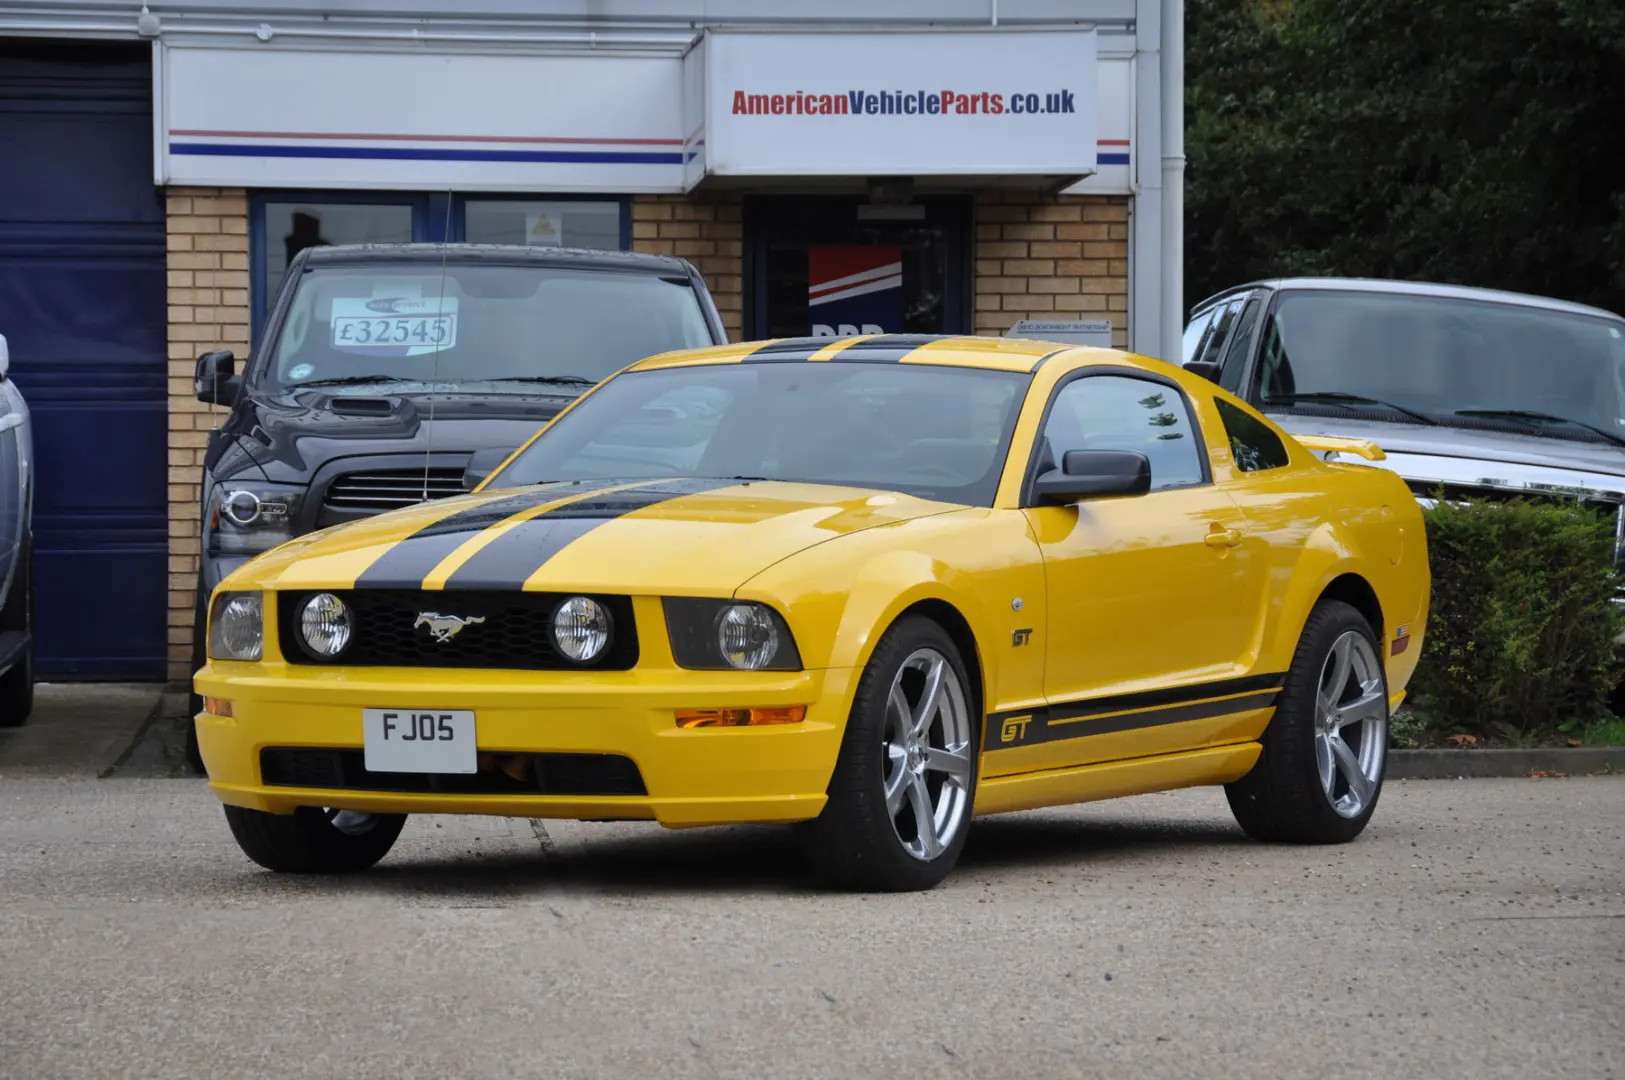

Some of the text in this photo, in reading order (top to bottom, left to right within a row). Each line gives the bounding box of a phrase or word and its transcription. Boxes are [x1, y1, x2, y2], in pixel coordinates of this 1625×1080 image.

[732, 89, 1075, 115] AmericanVehicleParts.co.uk
[339, 319, 447, 343] £32545
[1011, 628, 1033, 647] GT
[383, 713, 454, 741] FJ05
[1001, 715, 1033, 742] GT
